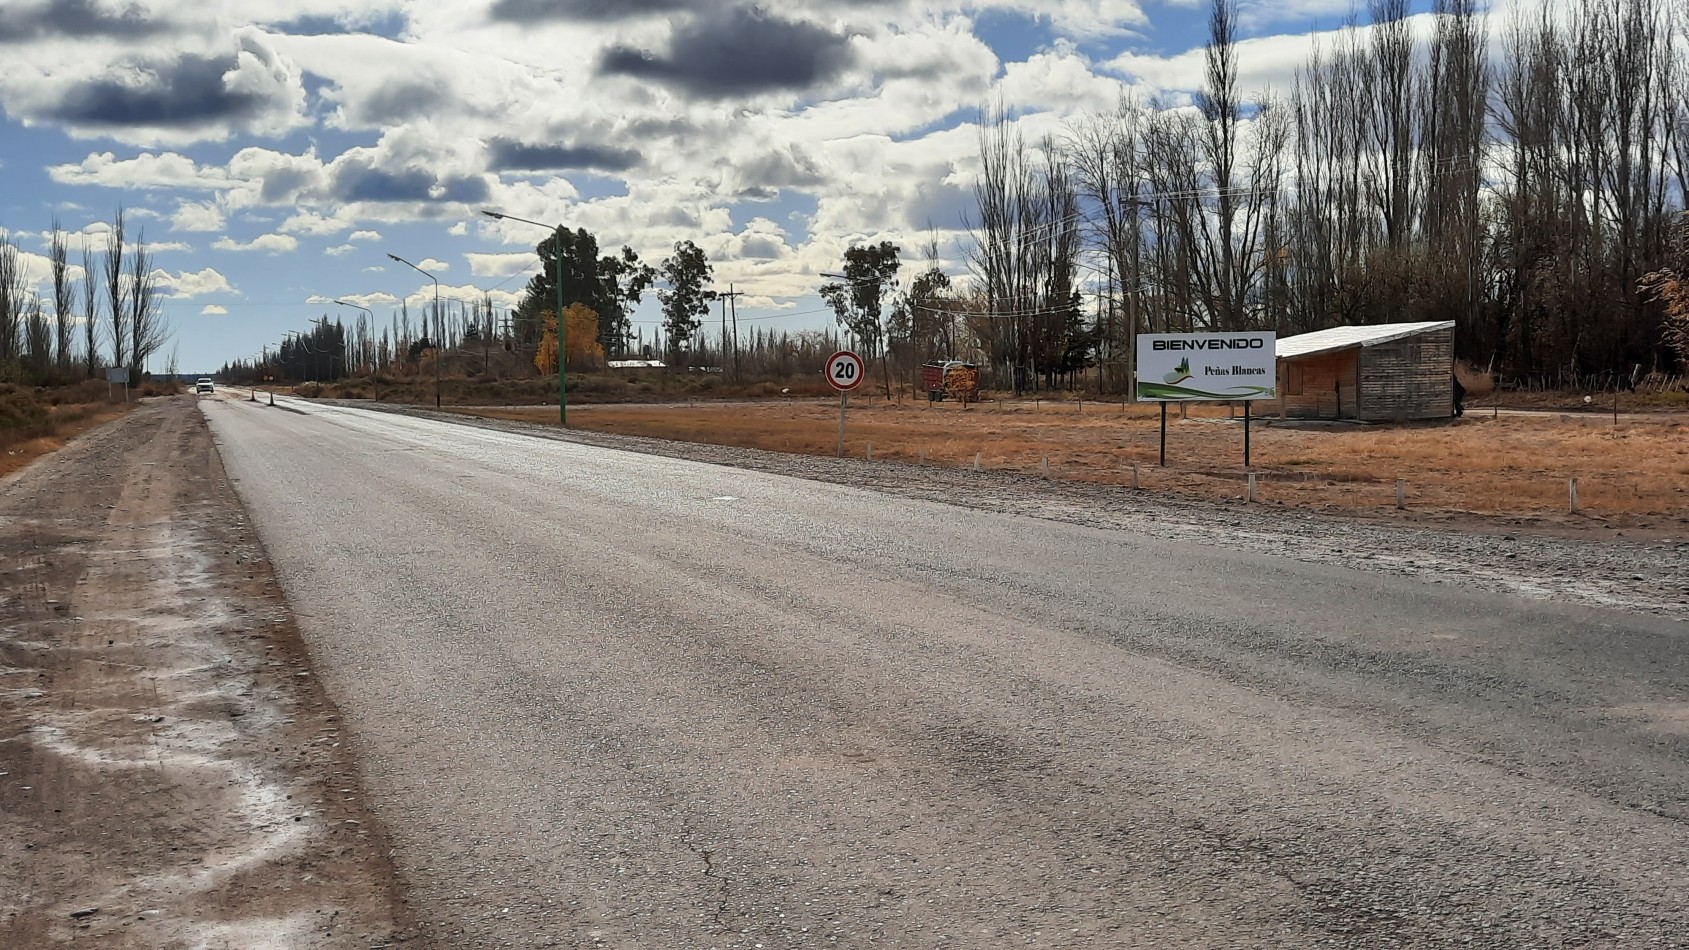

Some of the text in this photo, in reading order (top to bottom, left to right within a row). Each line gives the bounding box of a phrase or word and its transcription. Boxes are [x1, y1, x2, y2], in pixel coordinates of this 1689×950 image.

[1152, 338, 1264, 351] BIENVENIDO
[835, 361, 855, 379] 20
[1204, 365, 1266, 376] Peñas Blancas
